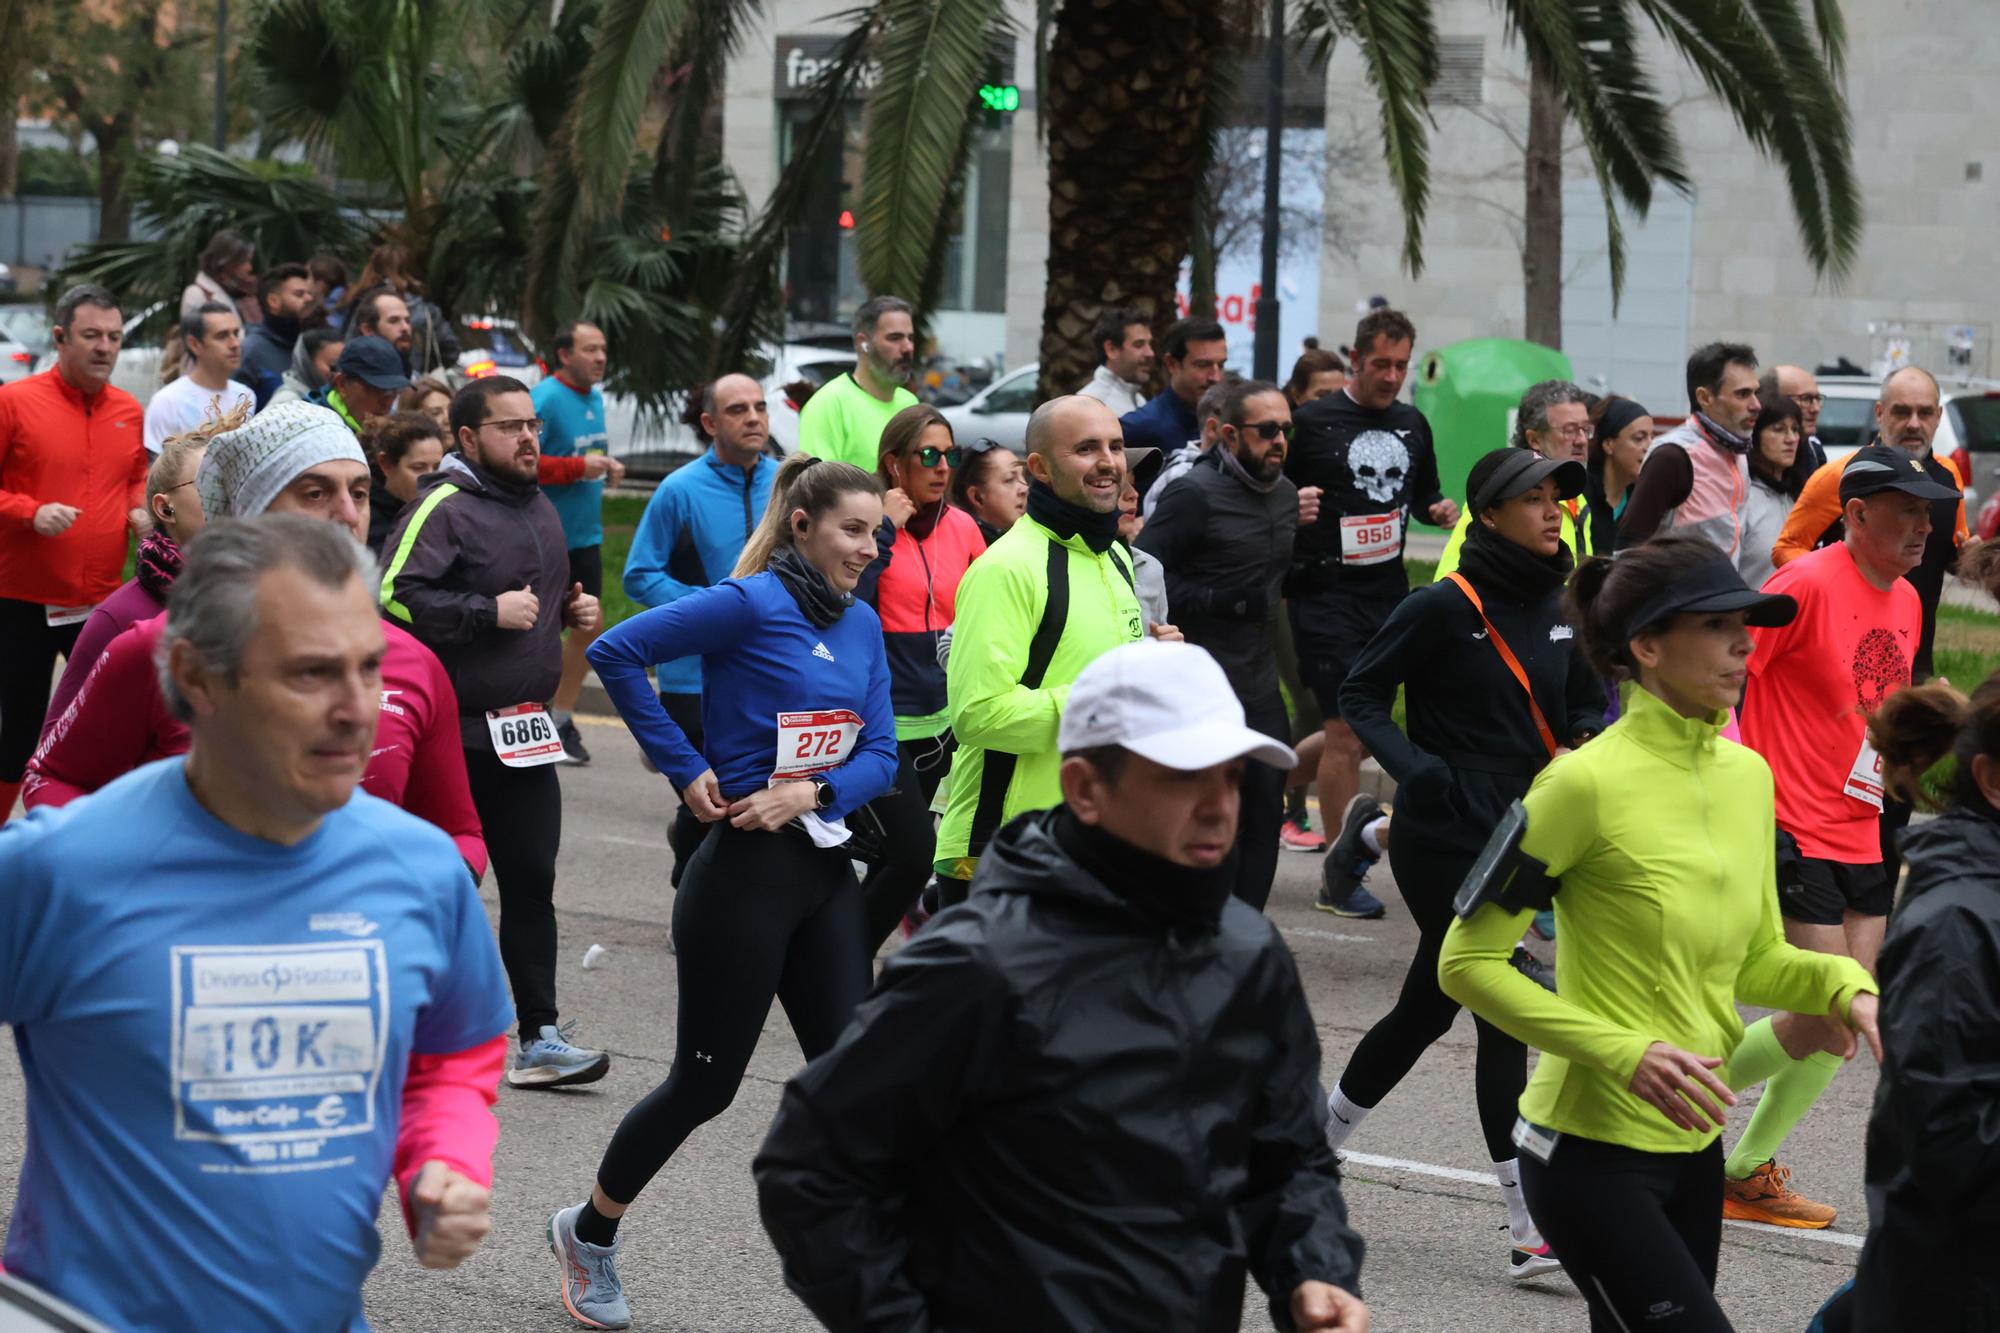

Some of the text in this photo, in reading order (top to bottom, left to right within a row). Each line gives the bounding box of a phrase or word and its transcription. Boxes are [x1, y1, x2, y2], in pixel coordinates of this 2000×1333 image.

[1356, 525, 1392, 545] 958
[812, 650, 835, 663] adidas
[501, 717, 551, 747] 6869
[796, 730, 842, 759] 272
